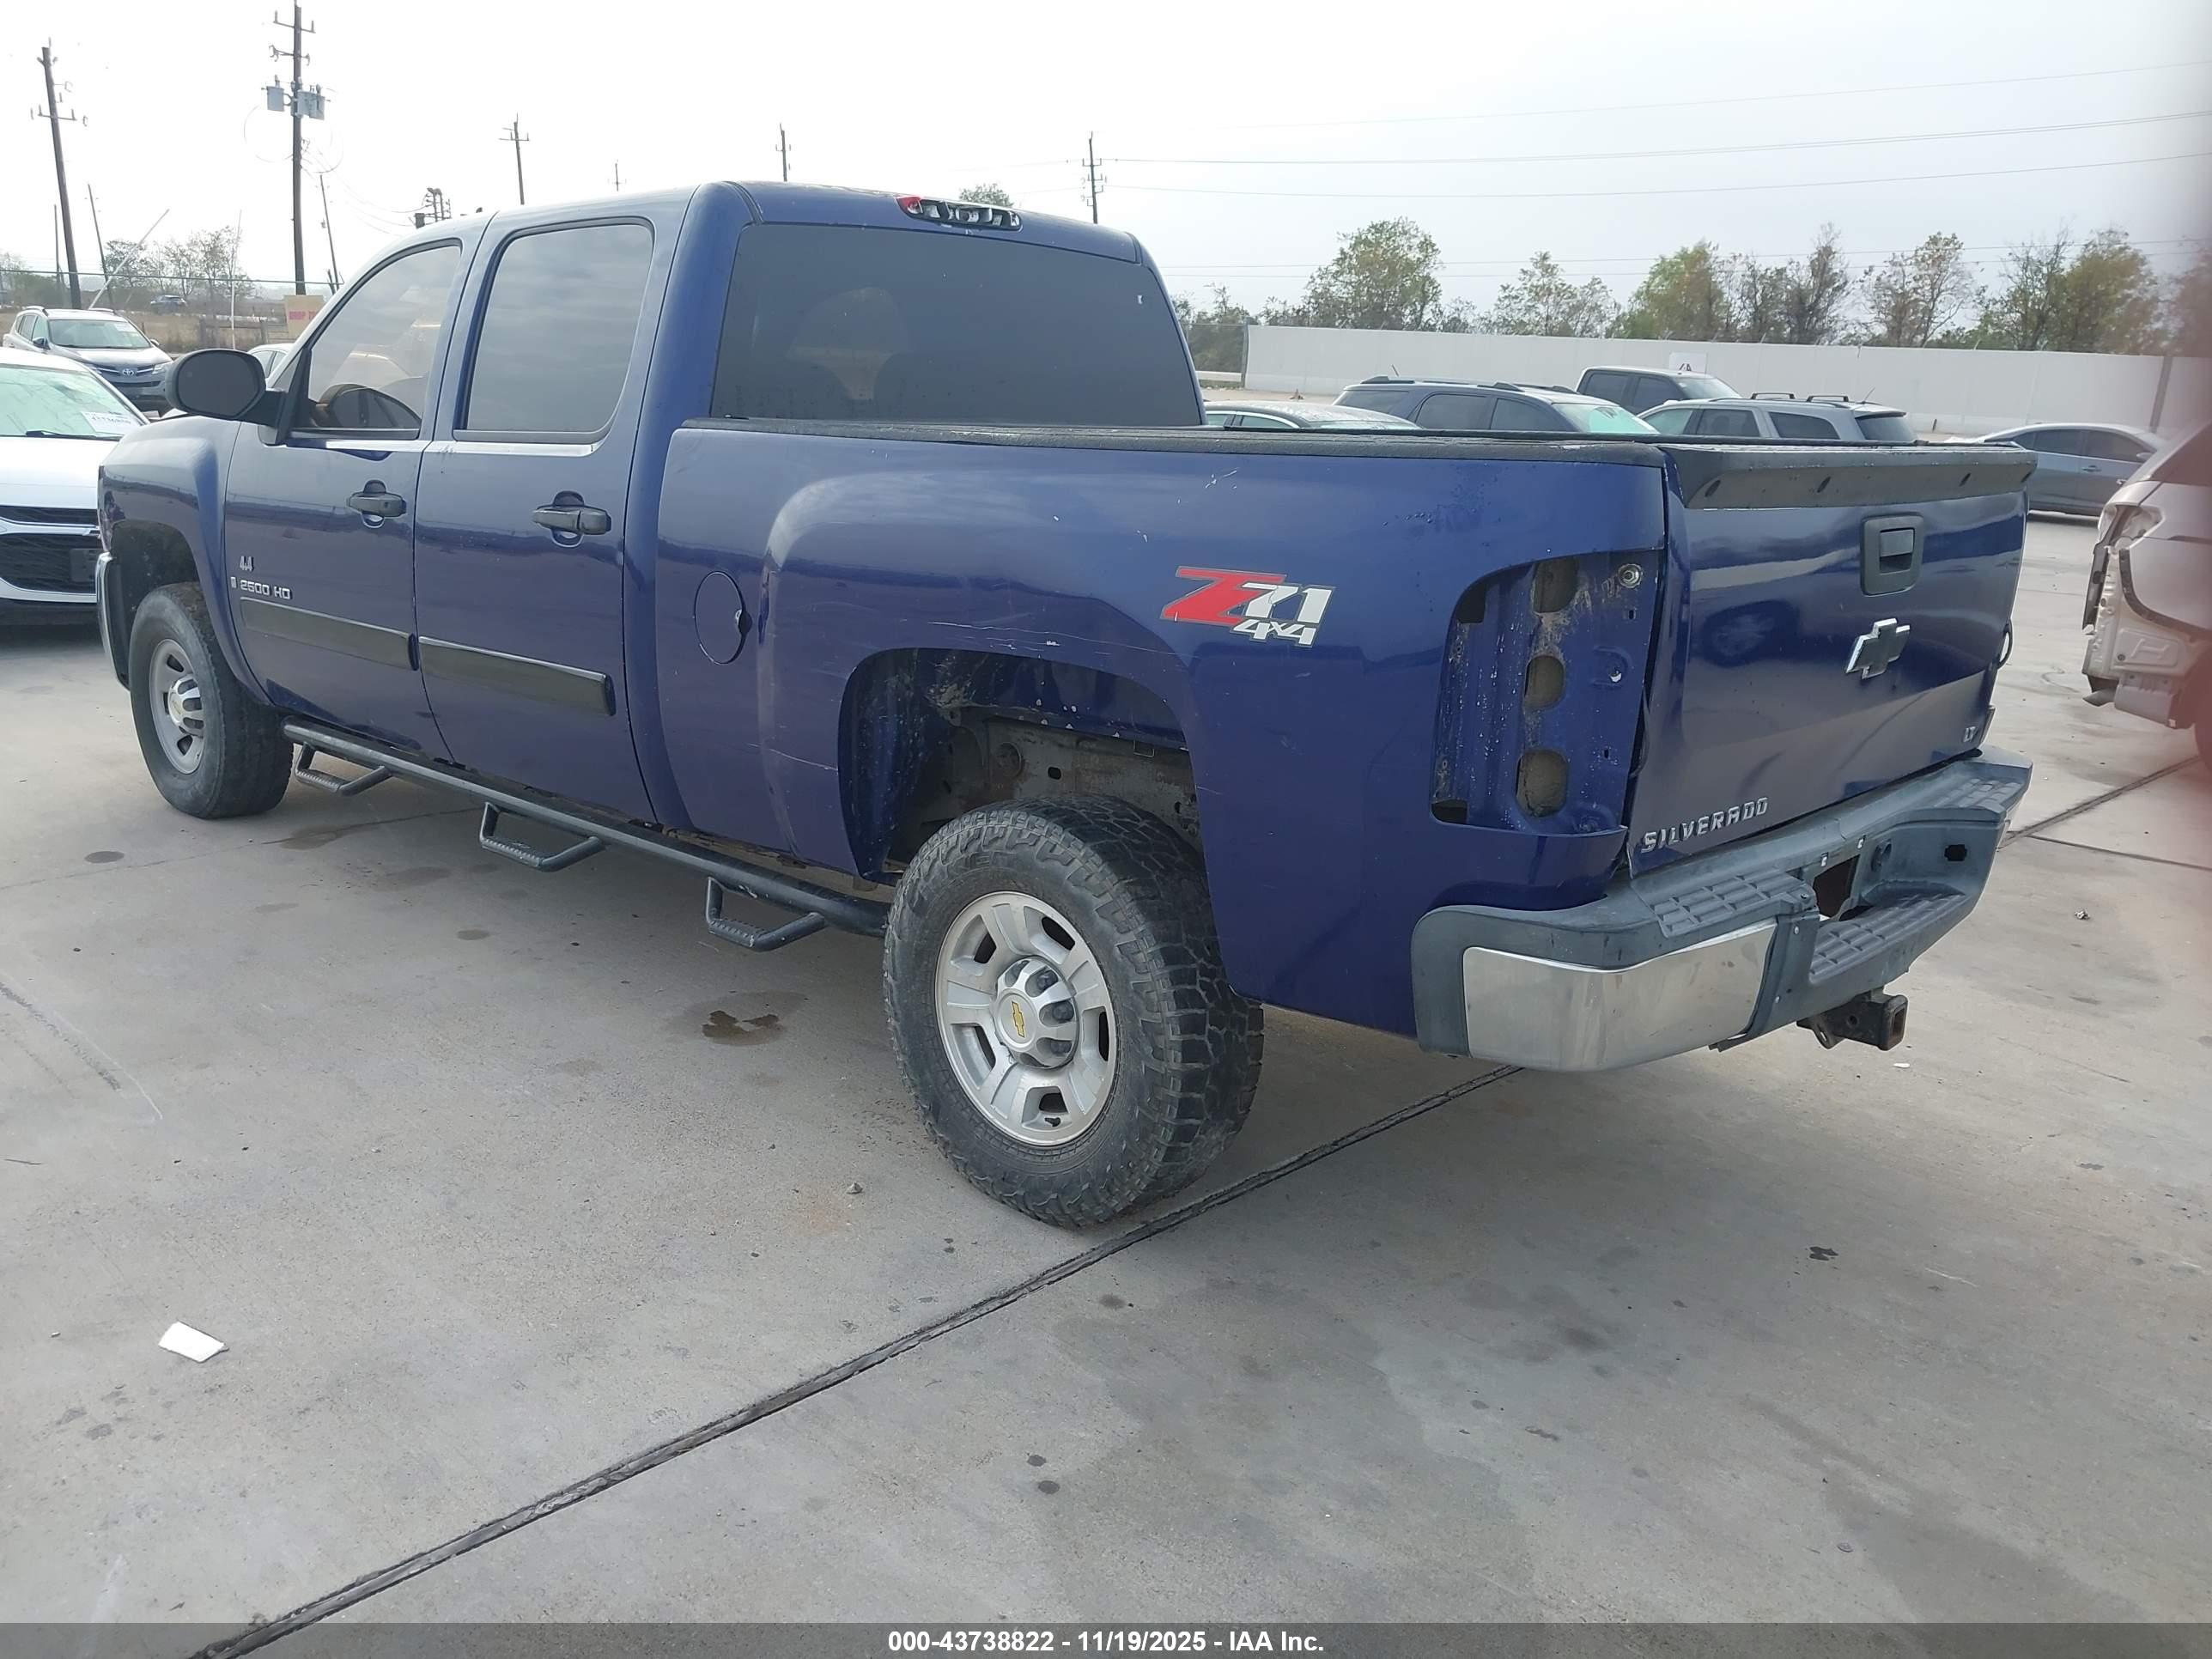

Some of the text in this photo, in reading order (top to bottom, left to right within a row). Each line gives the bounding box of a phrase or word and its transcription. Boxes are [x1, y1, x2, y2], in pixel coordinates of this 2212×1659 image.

[240, 580, 290, 599] 2500 HD
[1160, 566, 1336, 629] Z71
[1641, 797, 1768, 854] SILVERADO
